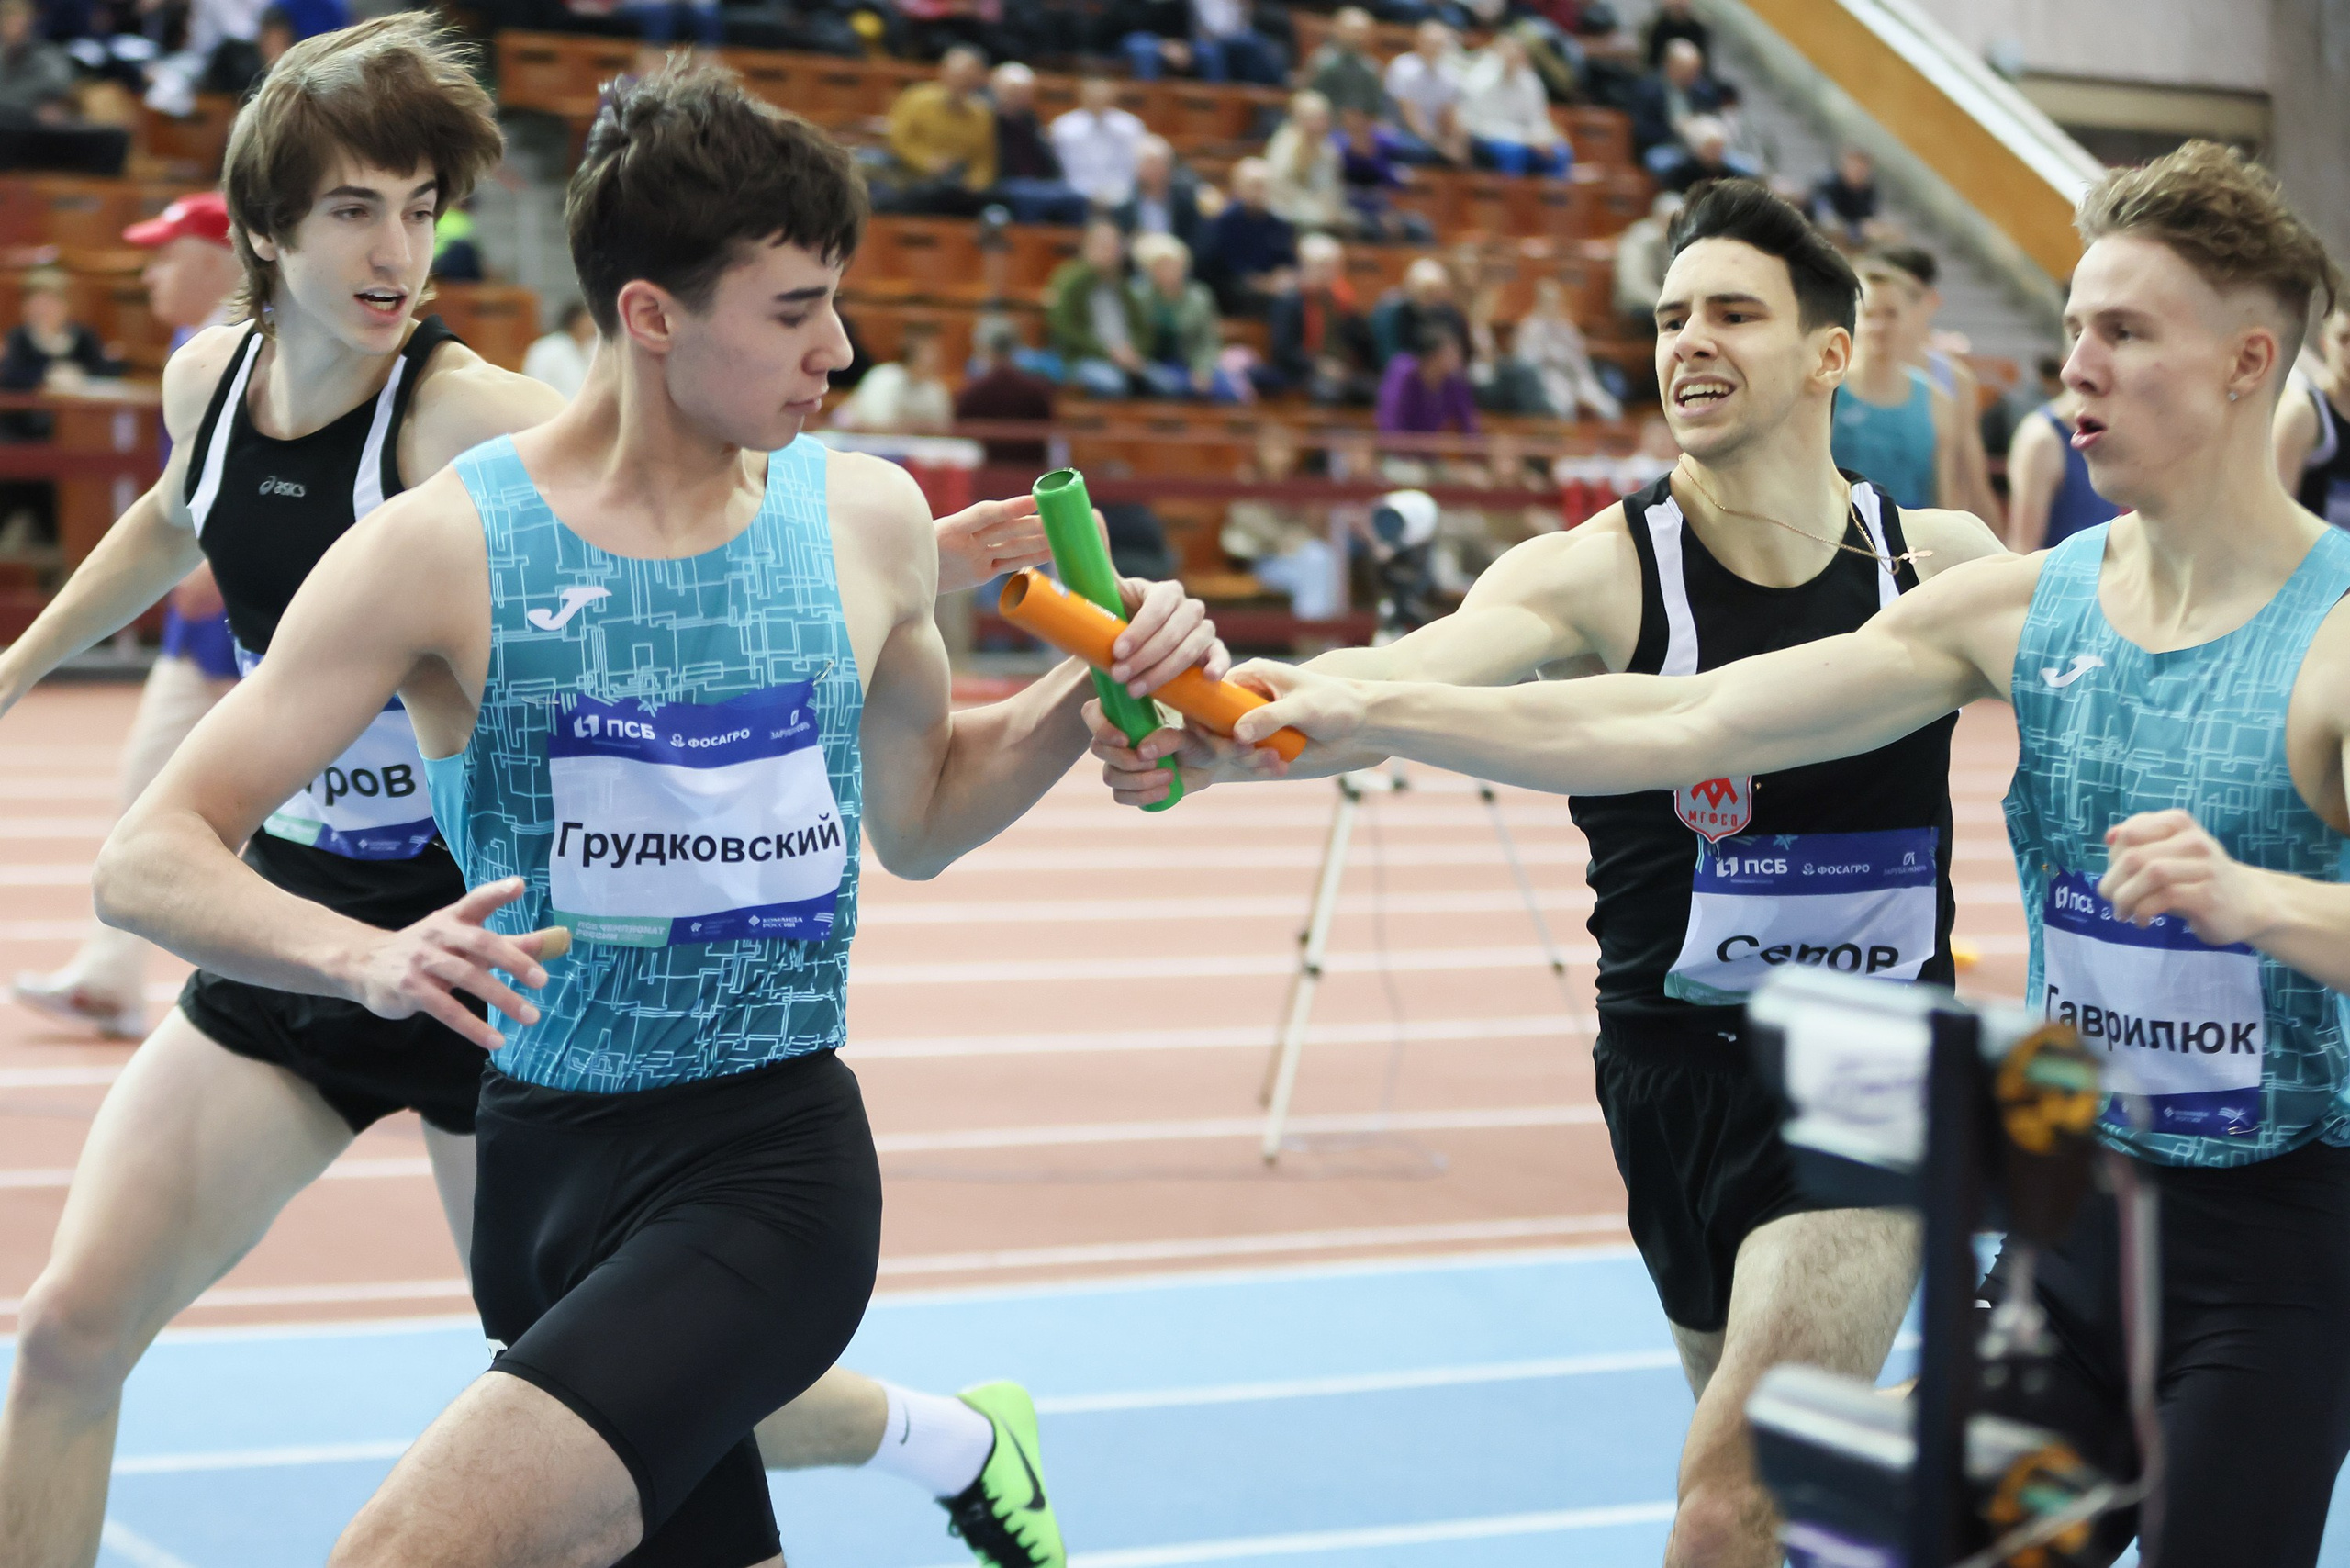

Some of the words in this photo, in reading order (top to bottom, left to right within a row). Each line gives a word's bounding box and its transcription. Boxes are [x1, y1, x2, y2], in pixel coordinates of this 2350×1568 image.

[606, 719, 656, 740] ПСБ
[688, 728, 751, 748] ФОСАГРО
[306, 763, 416, 807] ров
[1688, 810, 1738, 827] МГФСО
[557, 812, 842, 868] Грудковский
[1744, 858, 1788, 875] ПСБ
[1818, 864, 1871, 875] ФОСАГРО
[2069, 892, 2094, 914] ПСБ
[2044, 983, 2257, 1055] Гаврилюк
